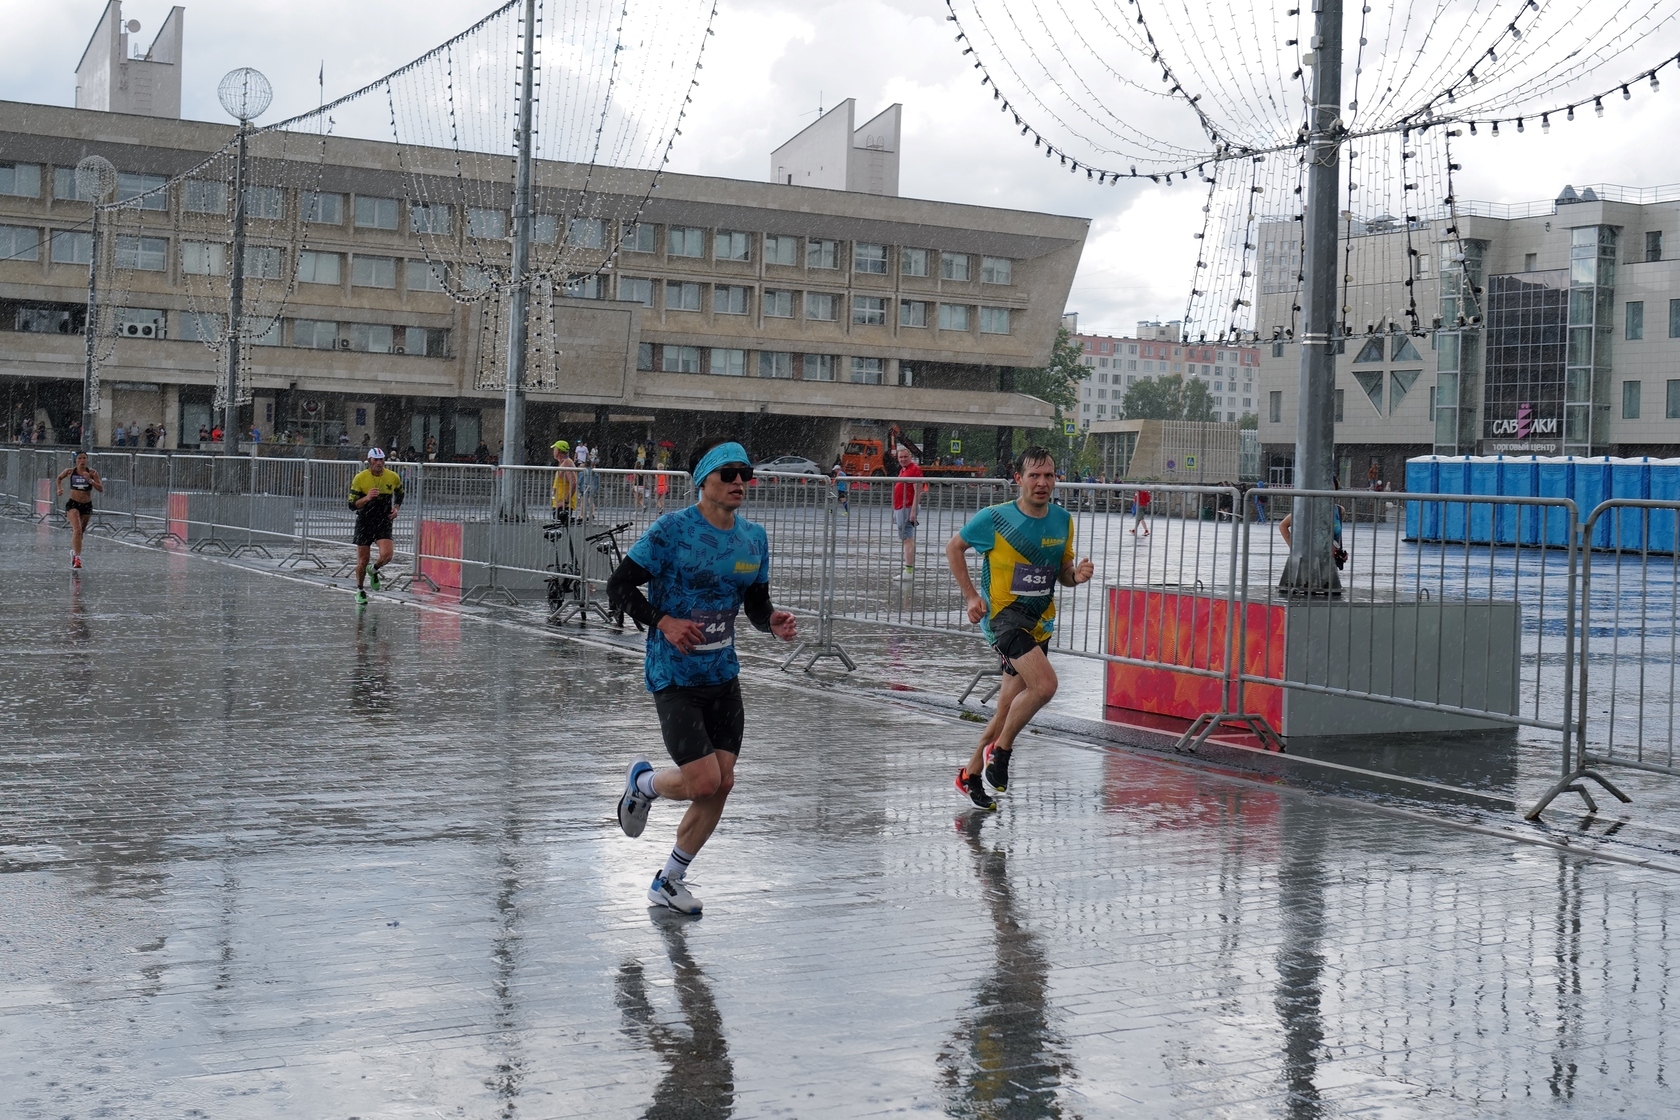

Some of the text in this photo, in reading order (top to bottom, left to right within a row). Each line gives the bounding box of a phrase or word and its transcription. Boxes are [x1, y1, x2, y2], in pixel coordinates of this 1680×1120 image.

[1493, 403, 1557, 440] САВЁЛКИ
[1492, 442, 1556, 453] торговый центр
[1022, 574, 1047, 584] 431
[705, 622, 726, 634] 44
